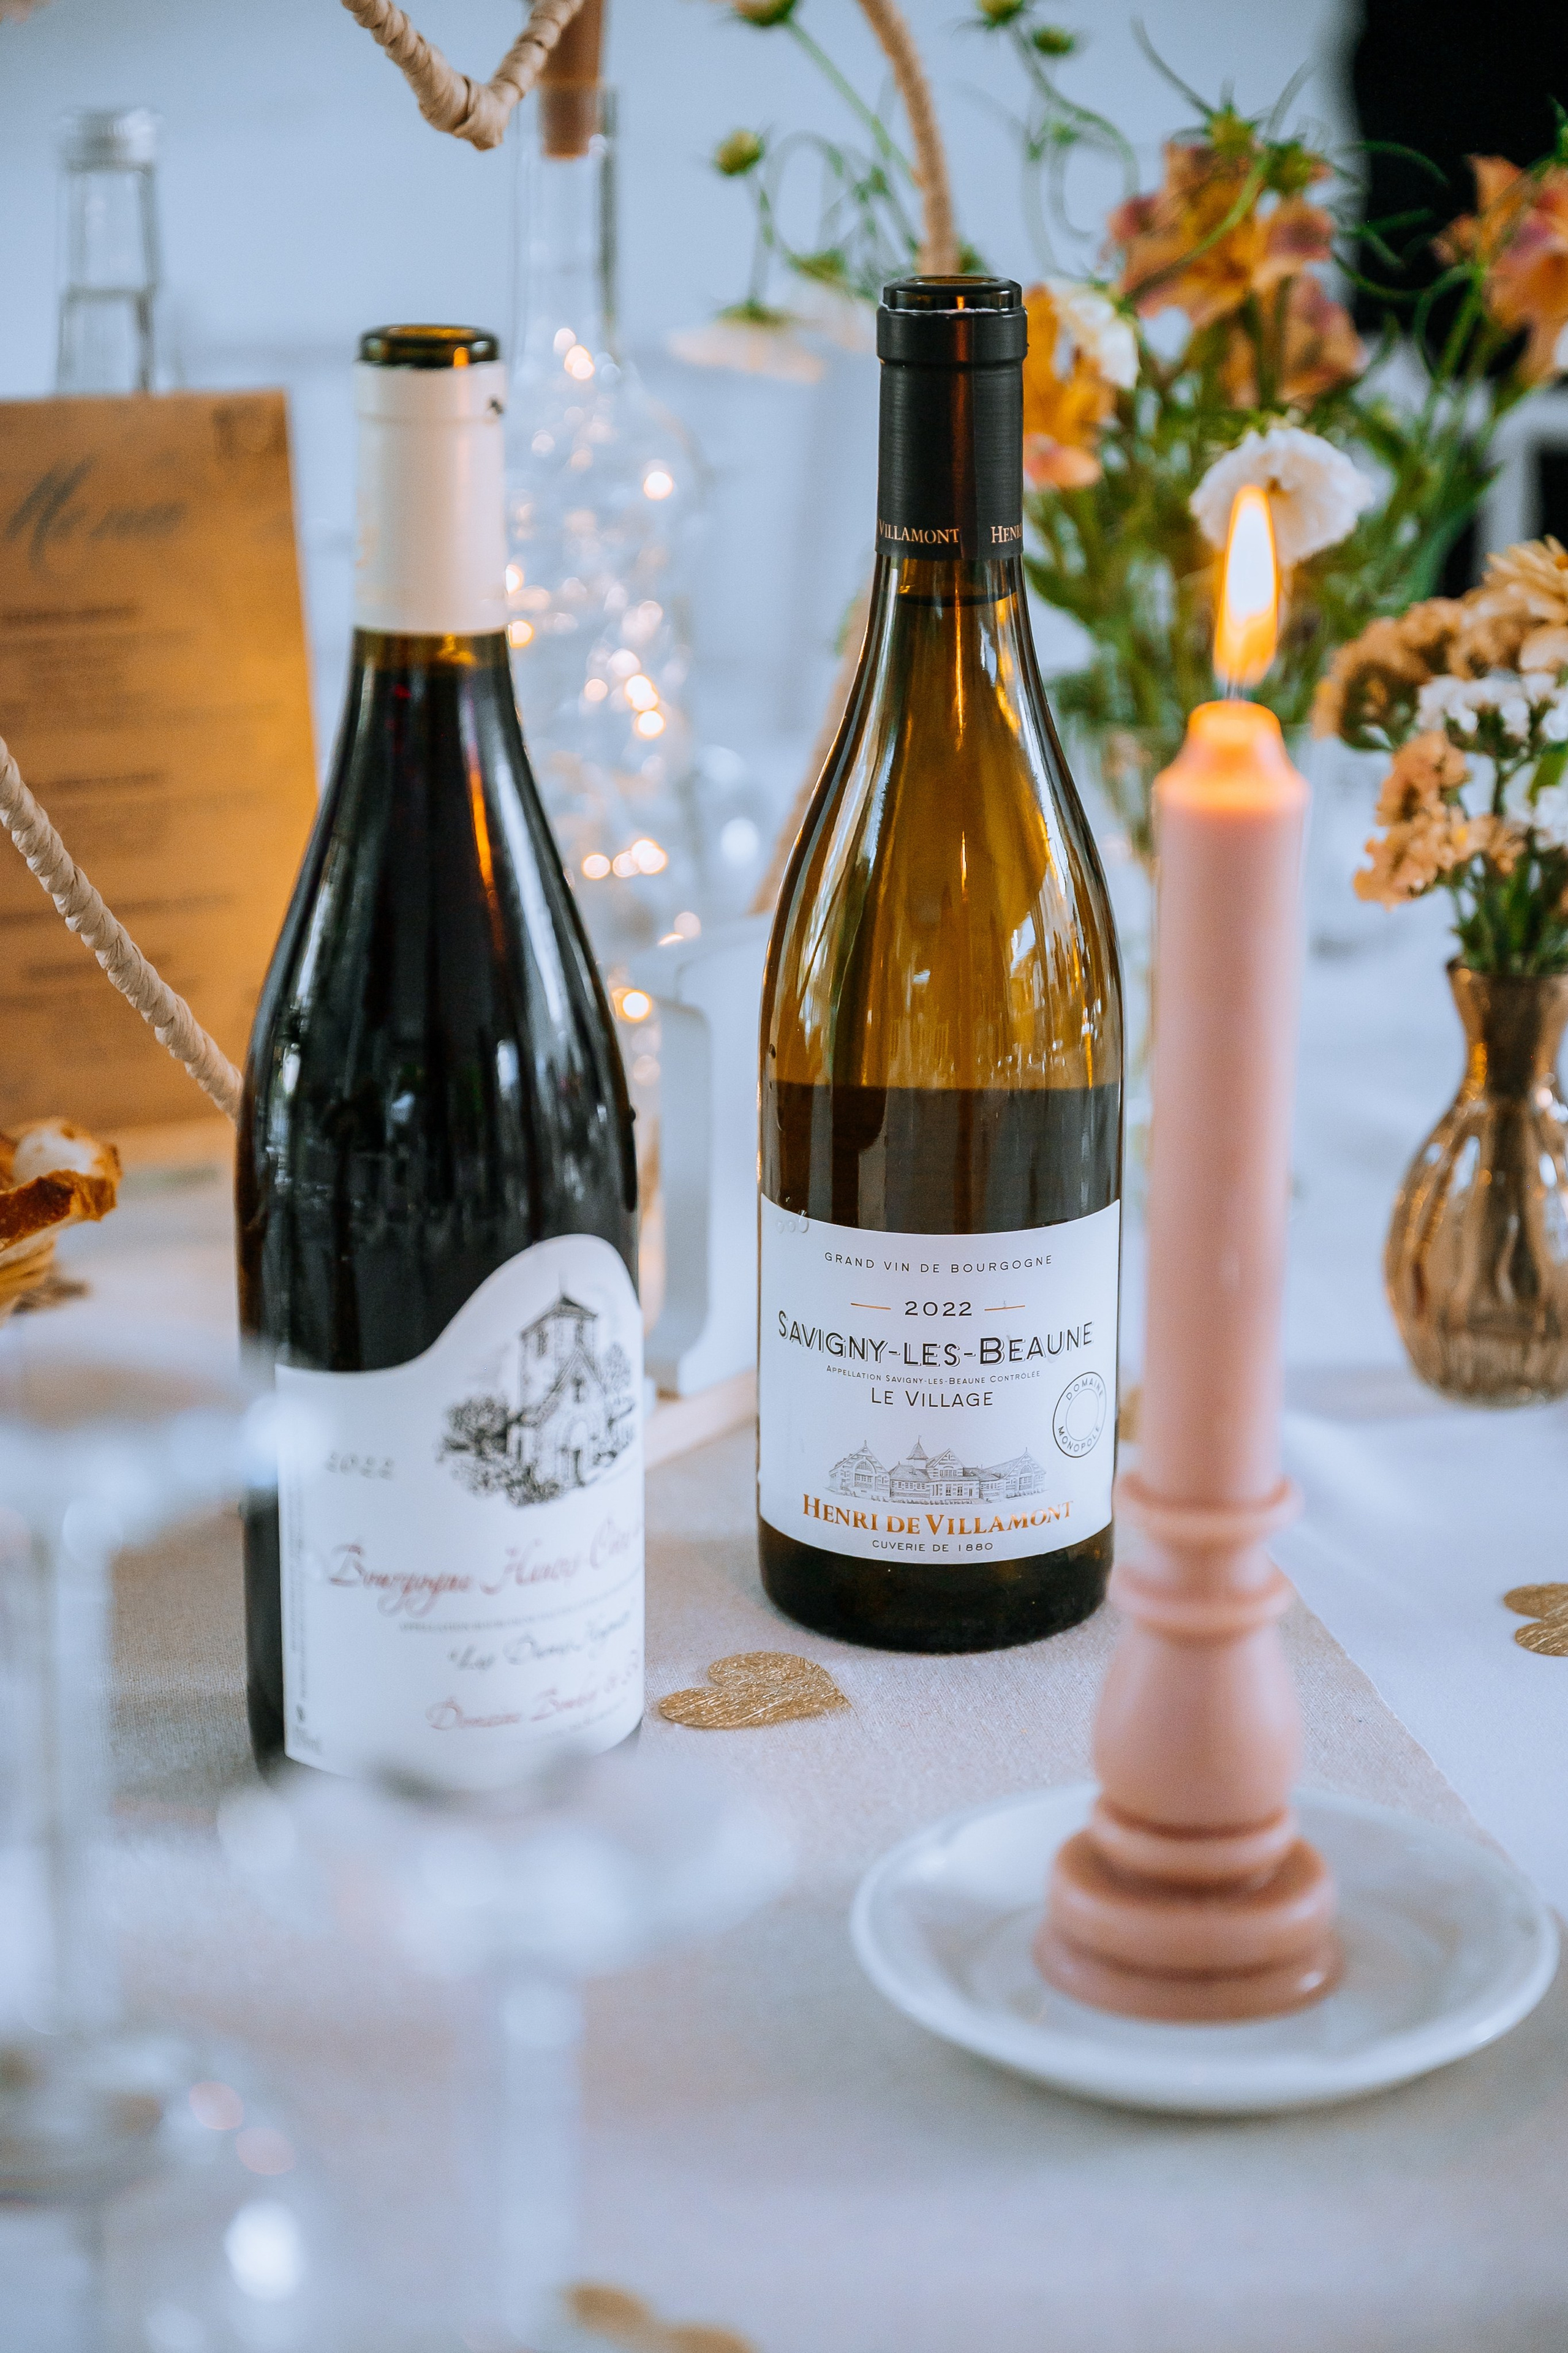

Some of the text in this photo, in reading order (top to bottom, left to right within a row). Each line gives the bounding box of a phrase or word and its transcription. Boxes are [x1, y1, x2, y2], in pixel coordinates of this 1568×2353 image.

[878, 519, 959, 544] VILLAMONT
[825, 1252, 1052, 1273] GRAND VIN DE BOURGOGNE
[905, 1300, 973, 1317] 2022
[778, 1309, 1094, 1367] SAVIGNY-LES-BEAUNE
[826, 1365, 881, 1381] APPELLATION
[886, 1375, 986, 1385] SAVIGNY-LES-BEAUNE
[871, 1387, 993, 1408] LE VILLAGE
[1066, 1377, 1104, 1401] DOMAINE
[1058, 1425, 1100, 1452] MONOPOLE
[803, 1493, 1074, 1536] HENRI DE VILLAMONT
[872, 1540, 993, 1552] CUVERIE DE 1880
